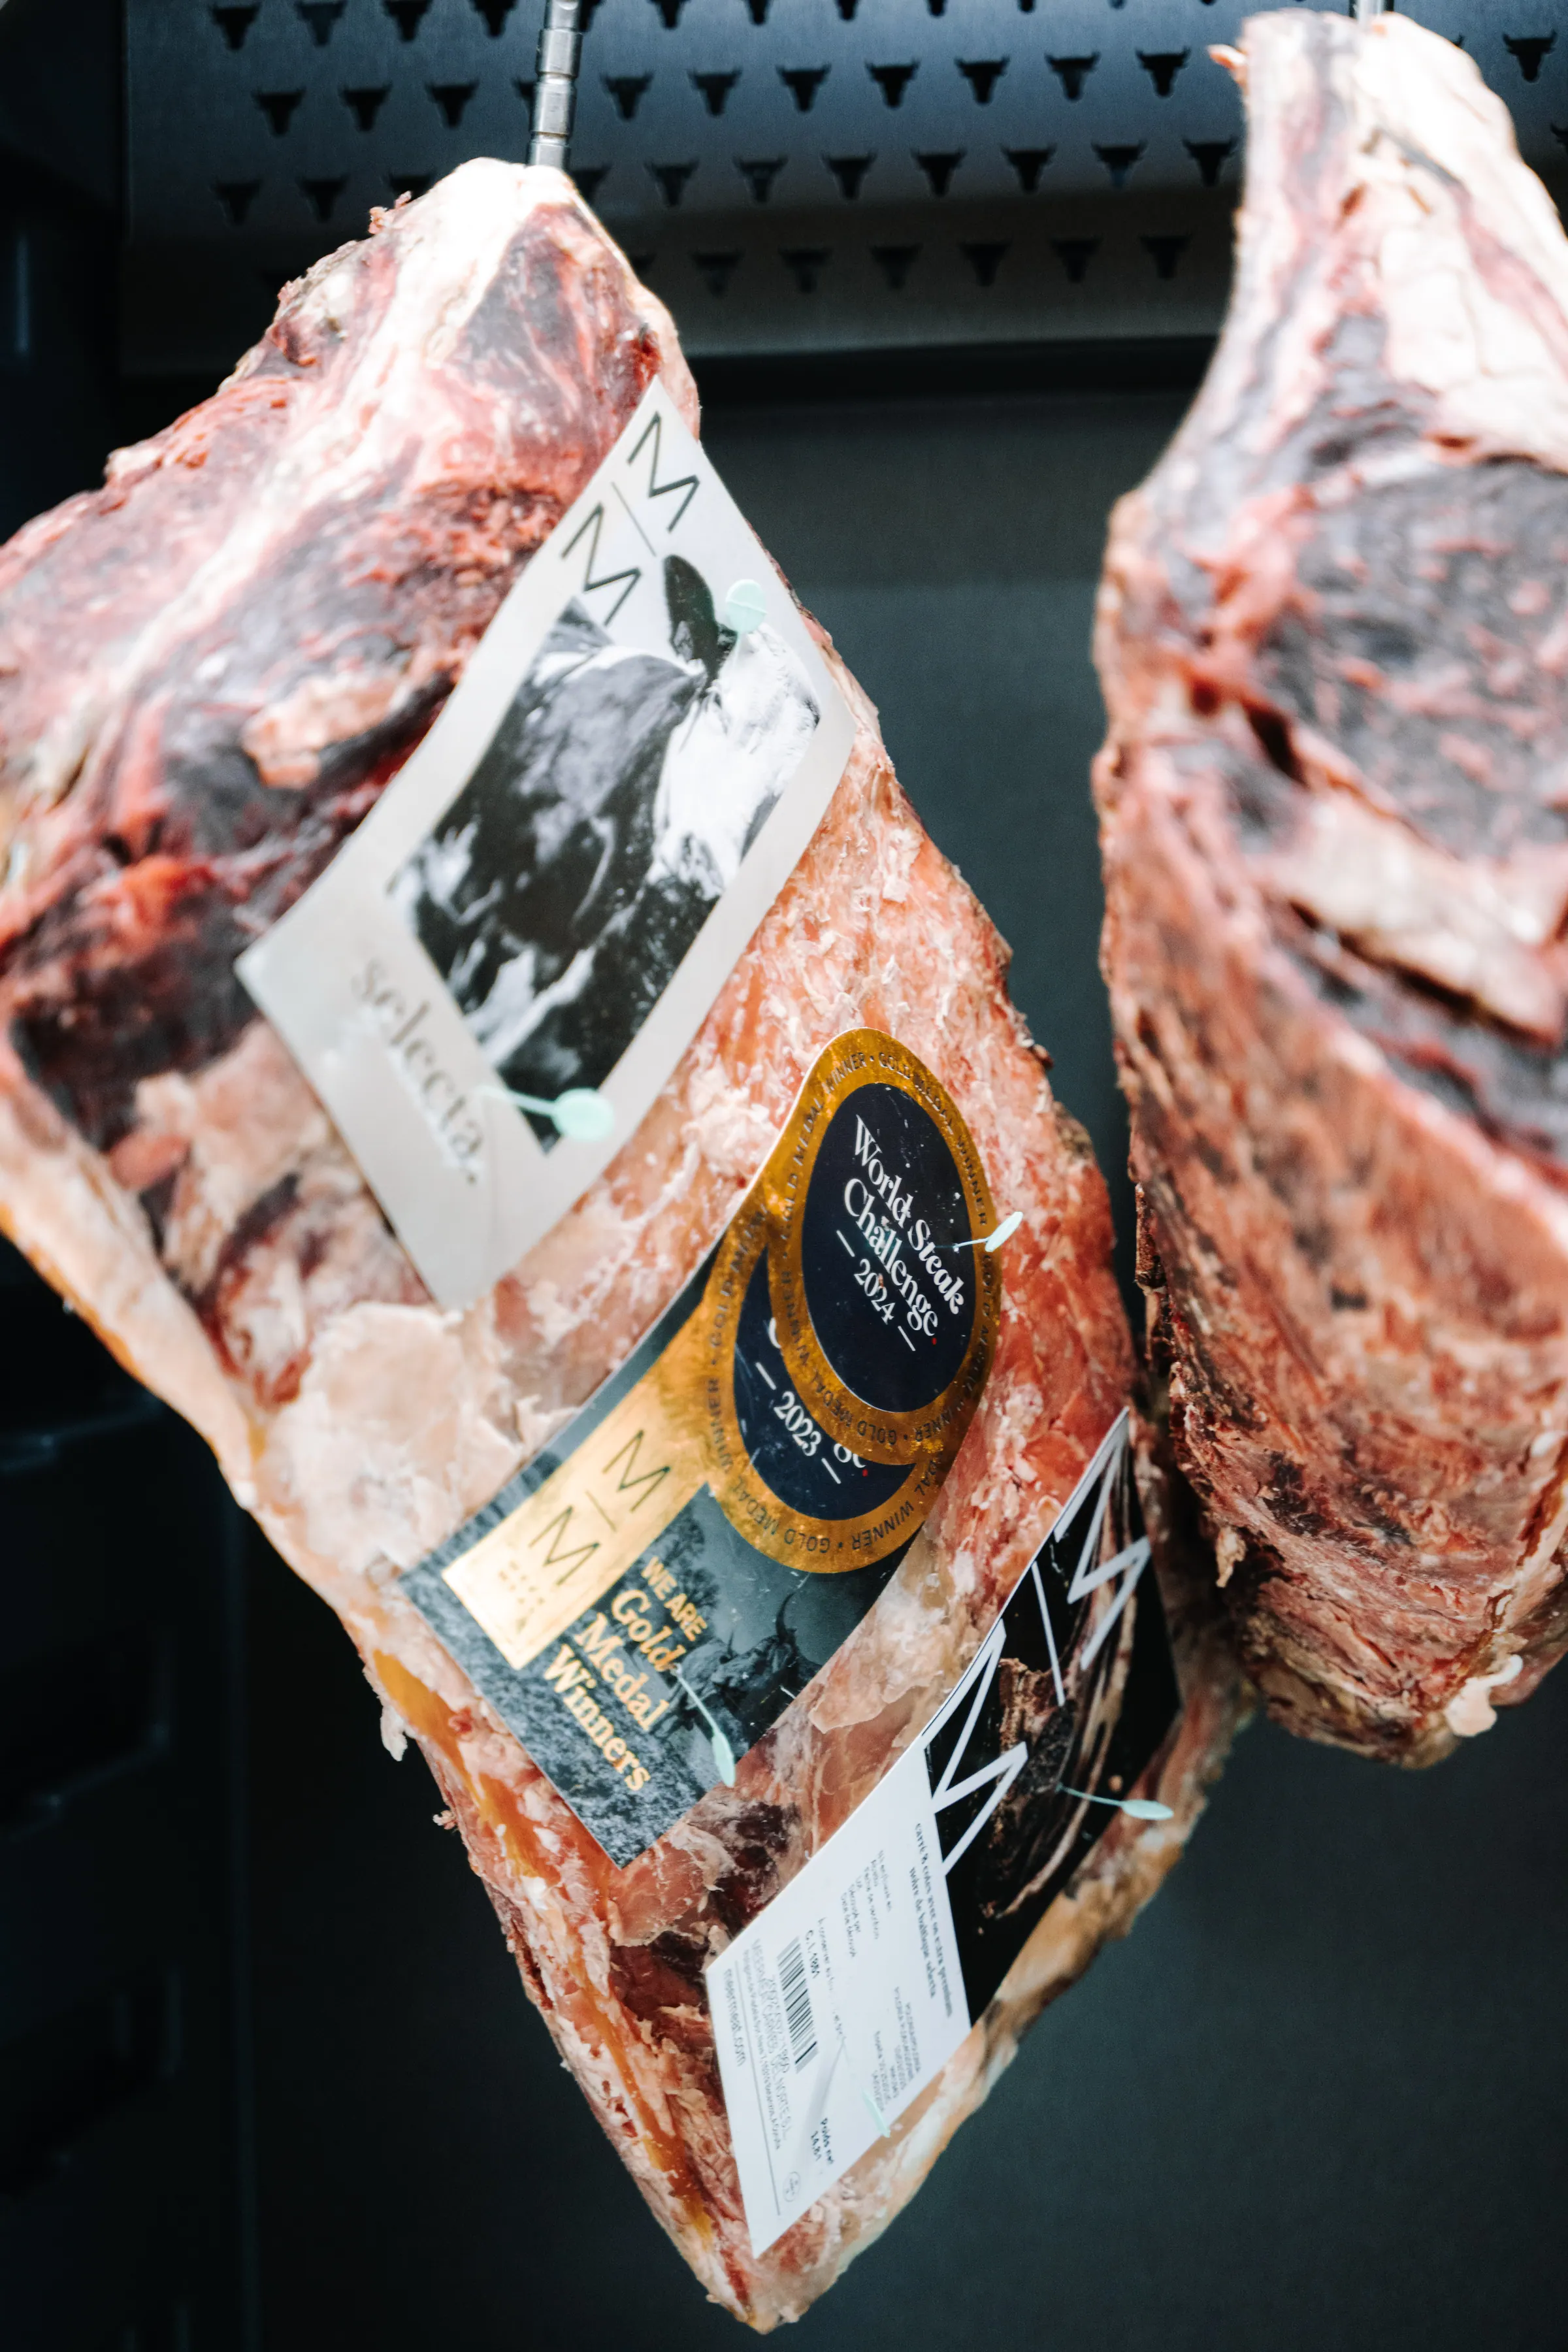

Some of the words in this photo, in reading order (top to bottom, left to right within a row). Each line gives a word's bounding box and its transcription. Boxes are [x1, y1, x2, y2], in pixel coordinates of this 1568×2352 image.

[627, 411, 700, 534] M
[561, 502, 642, 626] M
[879, 1051, 910, 1079] GOLD
[855, 1115, 913, 1228] World
[907, 1219, 964, 1315] Steak
[854, 1258, 895, 1325] 2024
[707, 1378, 733, 1473] WINNER
[774, 1391, 822, 1457] 2023
[857, 1420, 897, 1445] GOLD
[602, 1429, 671, 1512] M
[731, 1475, 781, 1535] MEDAL
[529, 1505, 600, 1586] M
[783, 1527, 831, 1554] GOLD
[852, 1500, 915, 1550] WINNER
[611, 1589, 686, 1673] Gold
[642, 1556, 677, 1601] WE
[664, 1593, 708, 1642] ARE
[575, 1612, 670, 1731] Medal
[544, 1643, 651, 1791] Winners
